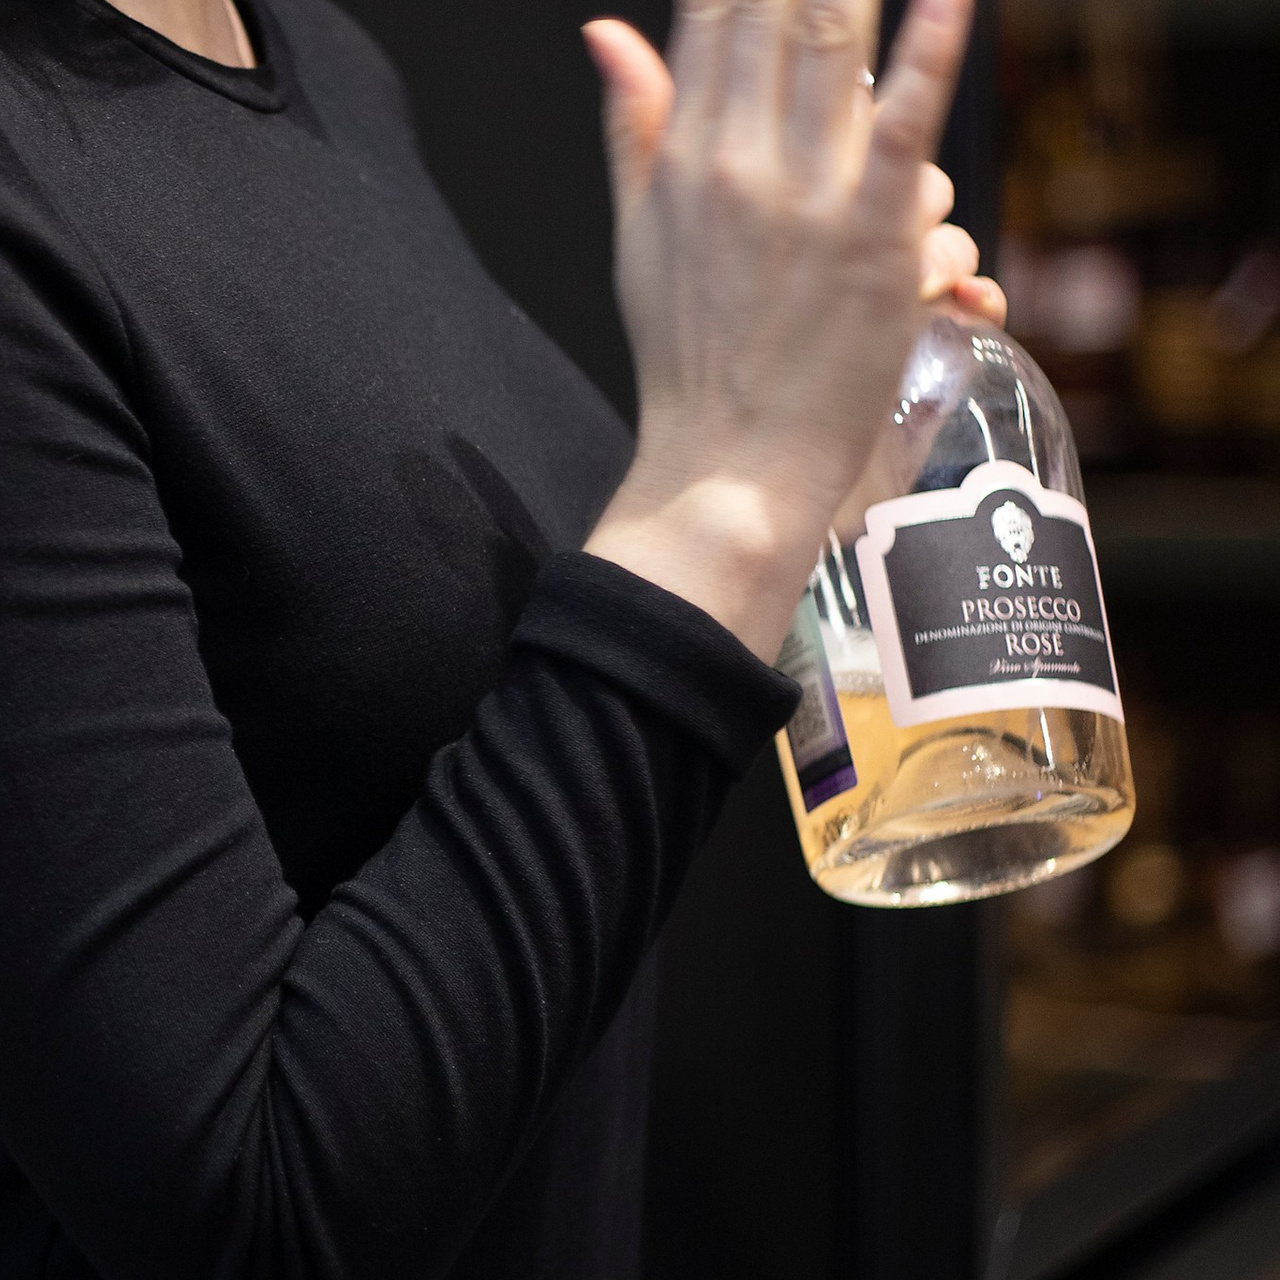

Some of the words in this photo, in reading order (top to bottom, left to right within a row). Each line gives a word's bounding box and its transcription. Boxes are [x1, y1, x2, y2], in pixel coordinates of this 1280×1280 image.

[976, 563, 1063, 590] FONTE
[961, 595, 1081, 623] PROSECCO
[914, 620, 1008, 646] DENOMINAZIONE
[1011, 620, 1023, 632] DI
[1025, 618, 1063, 634] ORIGINE
